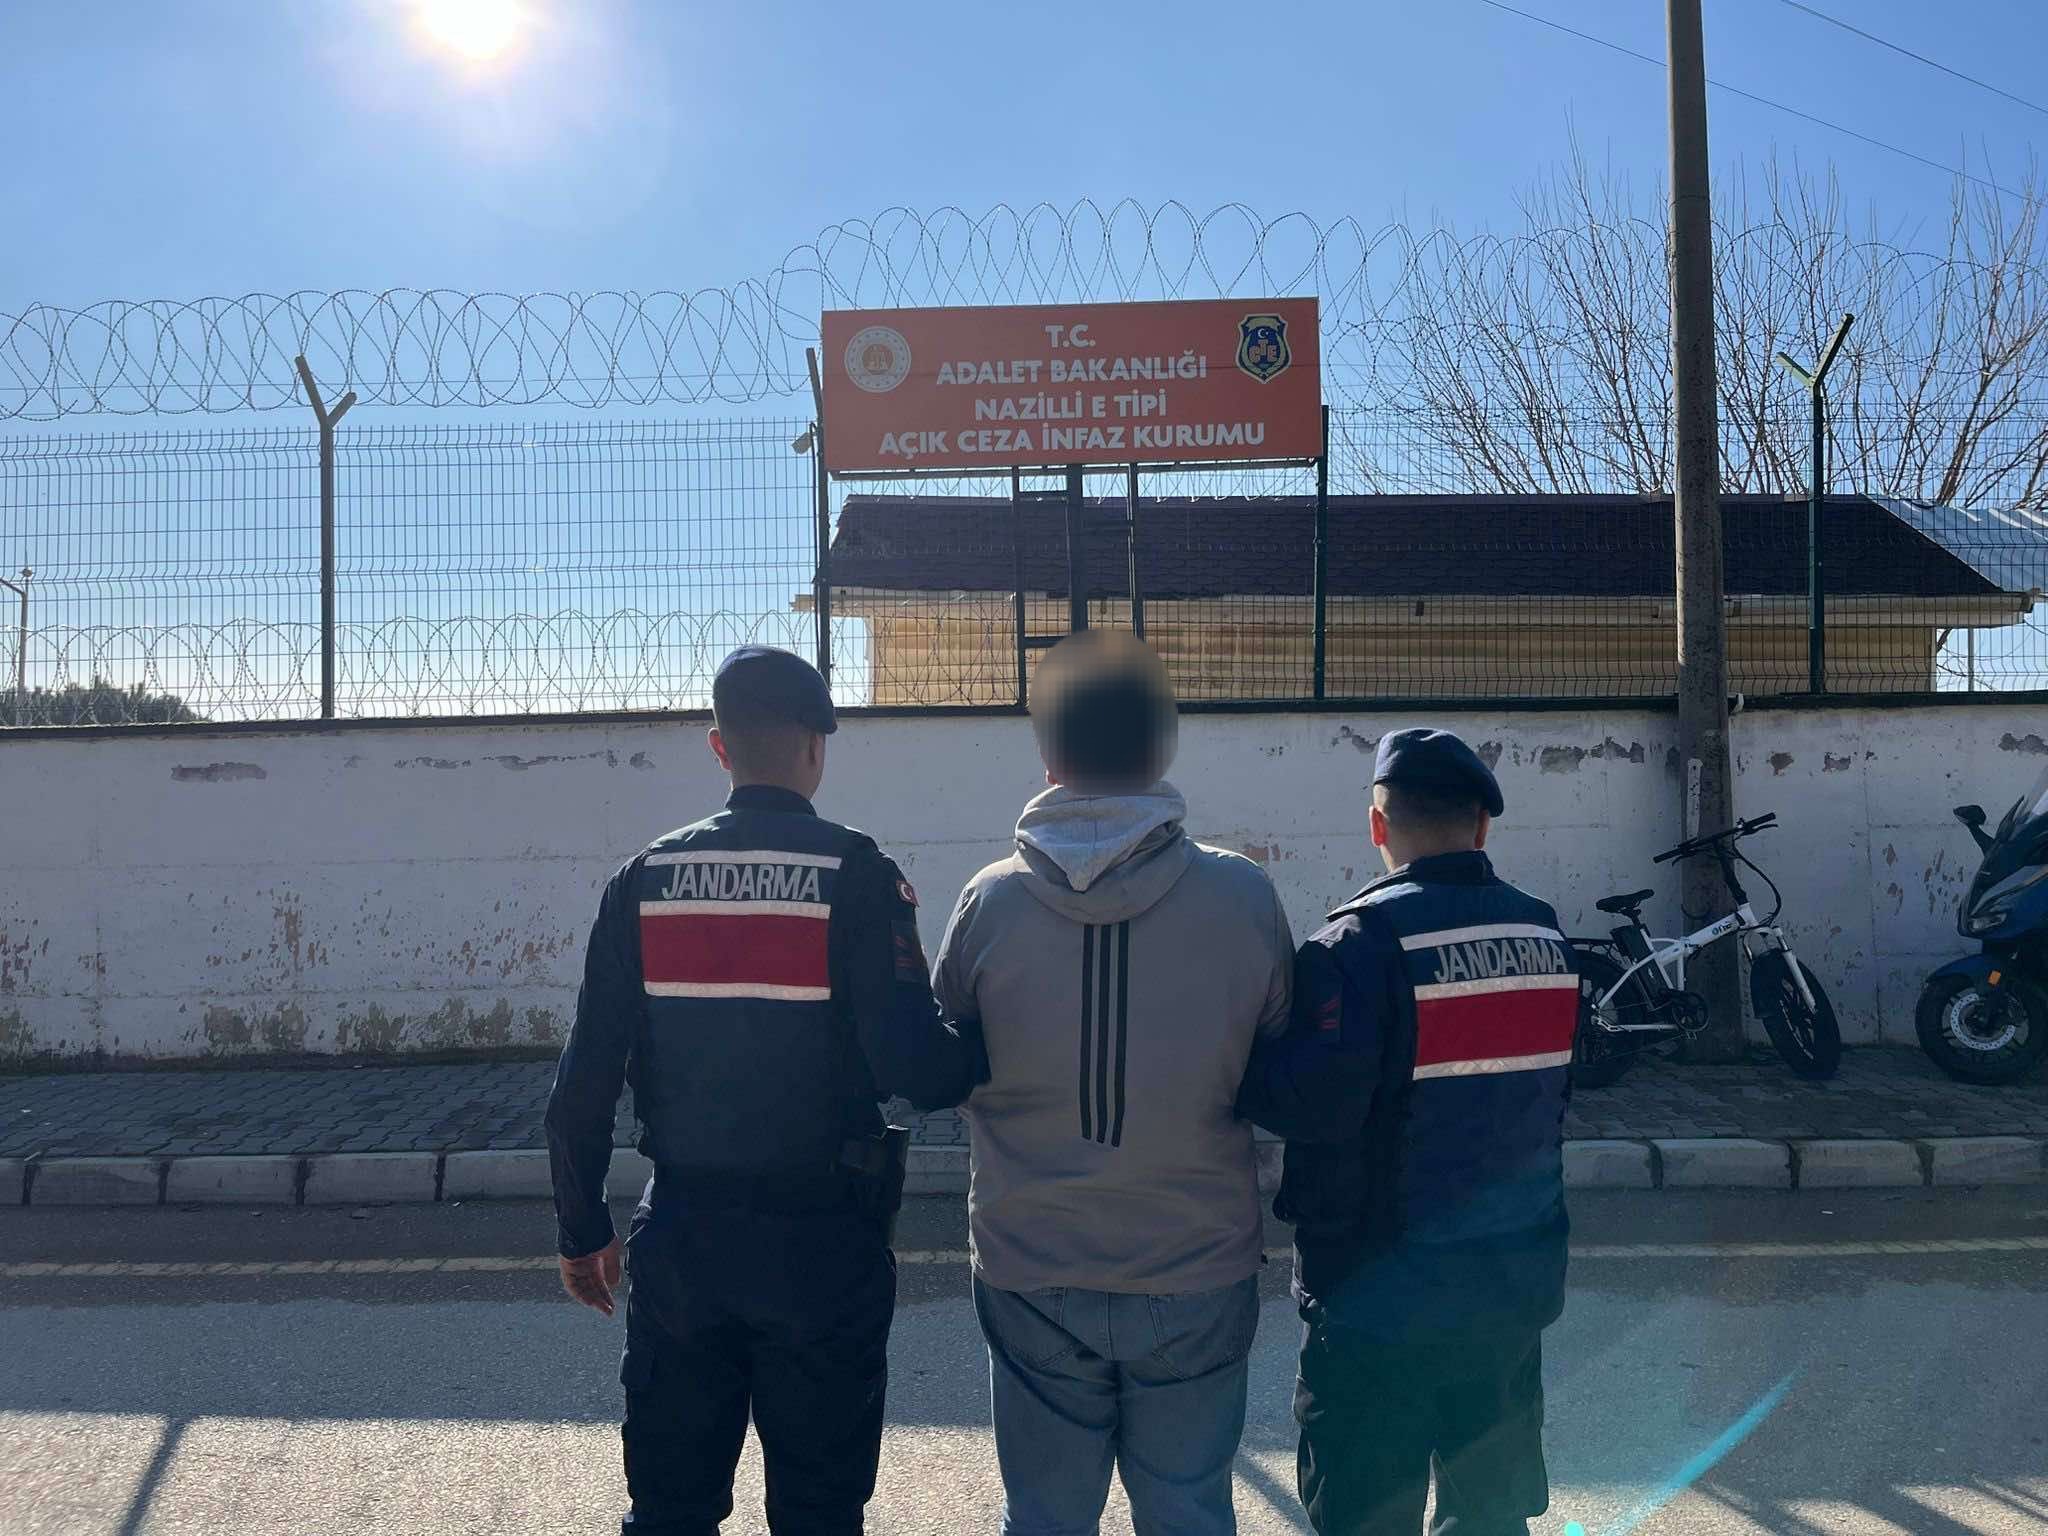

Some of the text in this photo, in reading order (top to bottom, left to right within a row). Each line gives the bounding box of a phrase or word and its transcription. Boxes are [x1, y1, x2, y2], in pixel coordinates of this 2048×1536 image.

[1045, 324, 1096, 348] T.C.
[936, 350, 1207, 385] ADALET BAKANLIĞI
[975, 388, 1167, 420] NAZİLLİ E TİPİ
[879, 423, 1265, 460] AÇIK CEZA İNFAZ KURUMU
[661, 864, 821, 901] JANDARMA
[1434, 937, 1569, 984] JANDARMA
